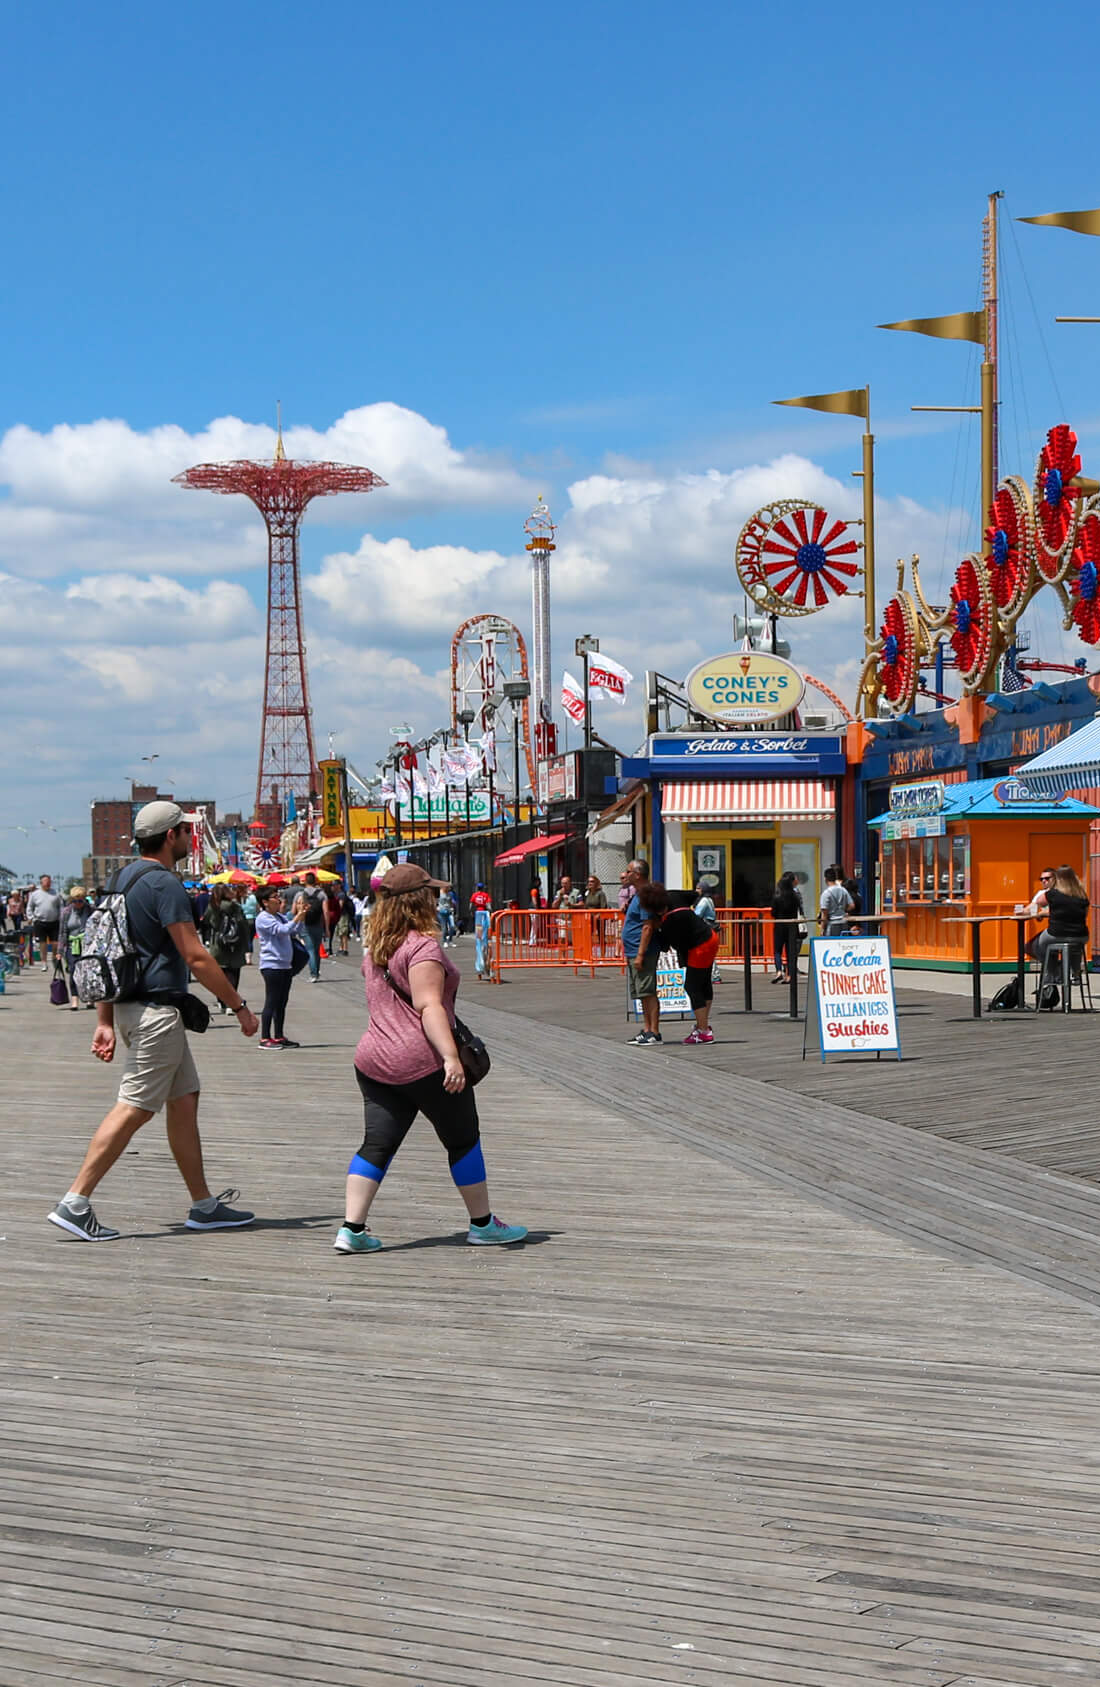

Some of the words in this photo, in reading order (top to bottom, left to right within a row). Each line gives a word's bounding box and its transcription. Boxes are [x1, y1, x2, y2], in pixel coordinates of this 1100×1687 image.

[702, 675, 789, 690] CONEY'S
[712, 691, 780, 704] CONES
[684, 739, 738, 755] Gelato
[740, 741, 750, 751] &
[752, 738, 808, 752] Sorbet
[823, 949, 843, 967] Ice
[843, 951, 882, 967] Cream
[820, 970, 864, 996] FUNNEL
[864, 968, 889, 994] CAKE
[825, 1002, 867, 1018] ITALIAN
[867, 1001, 889, 1016] ICES
[827, 1019, 890, 1038] Slushies
